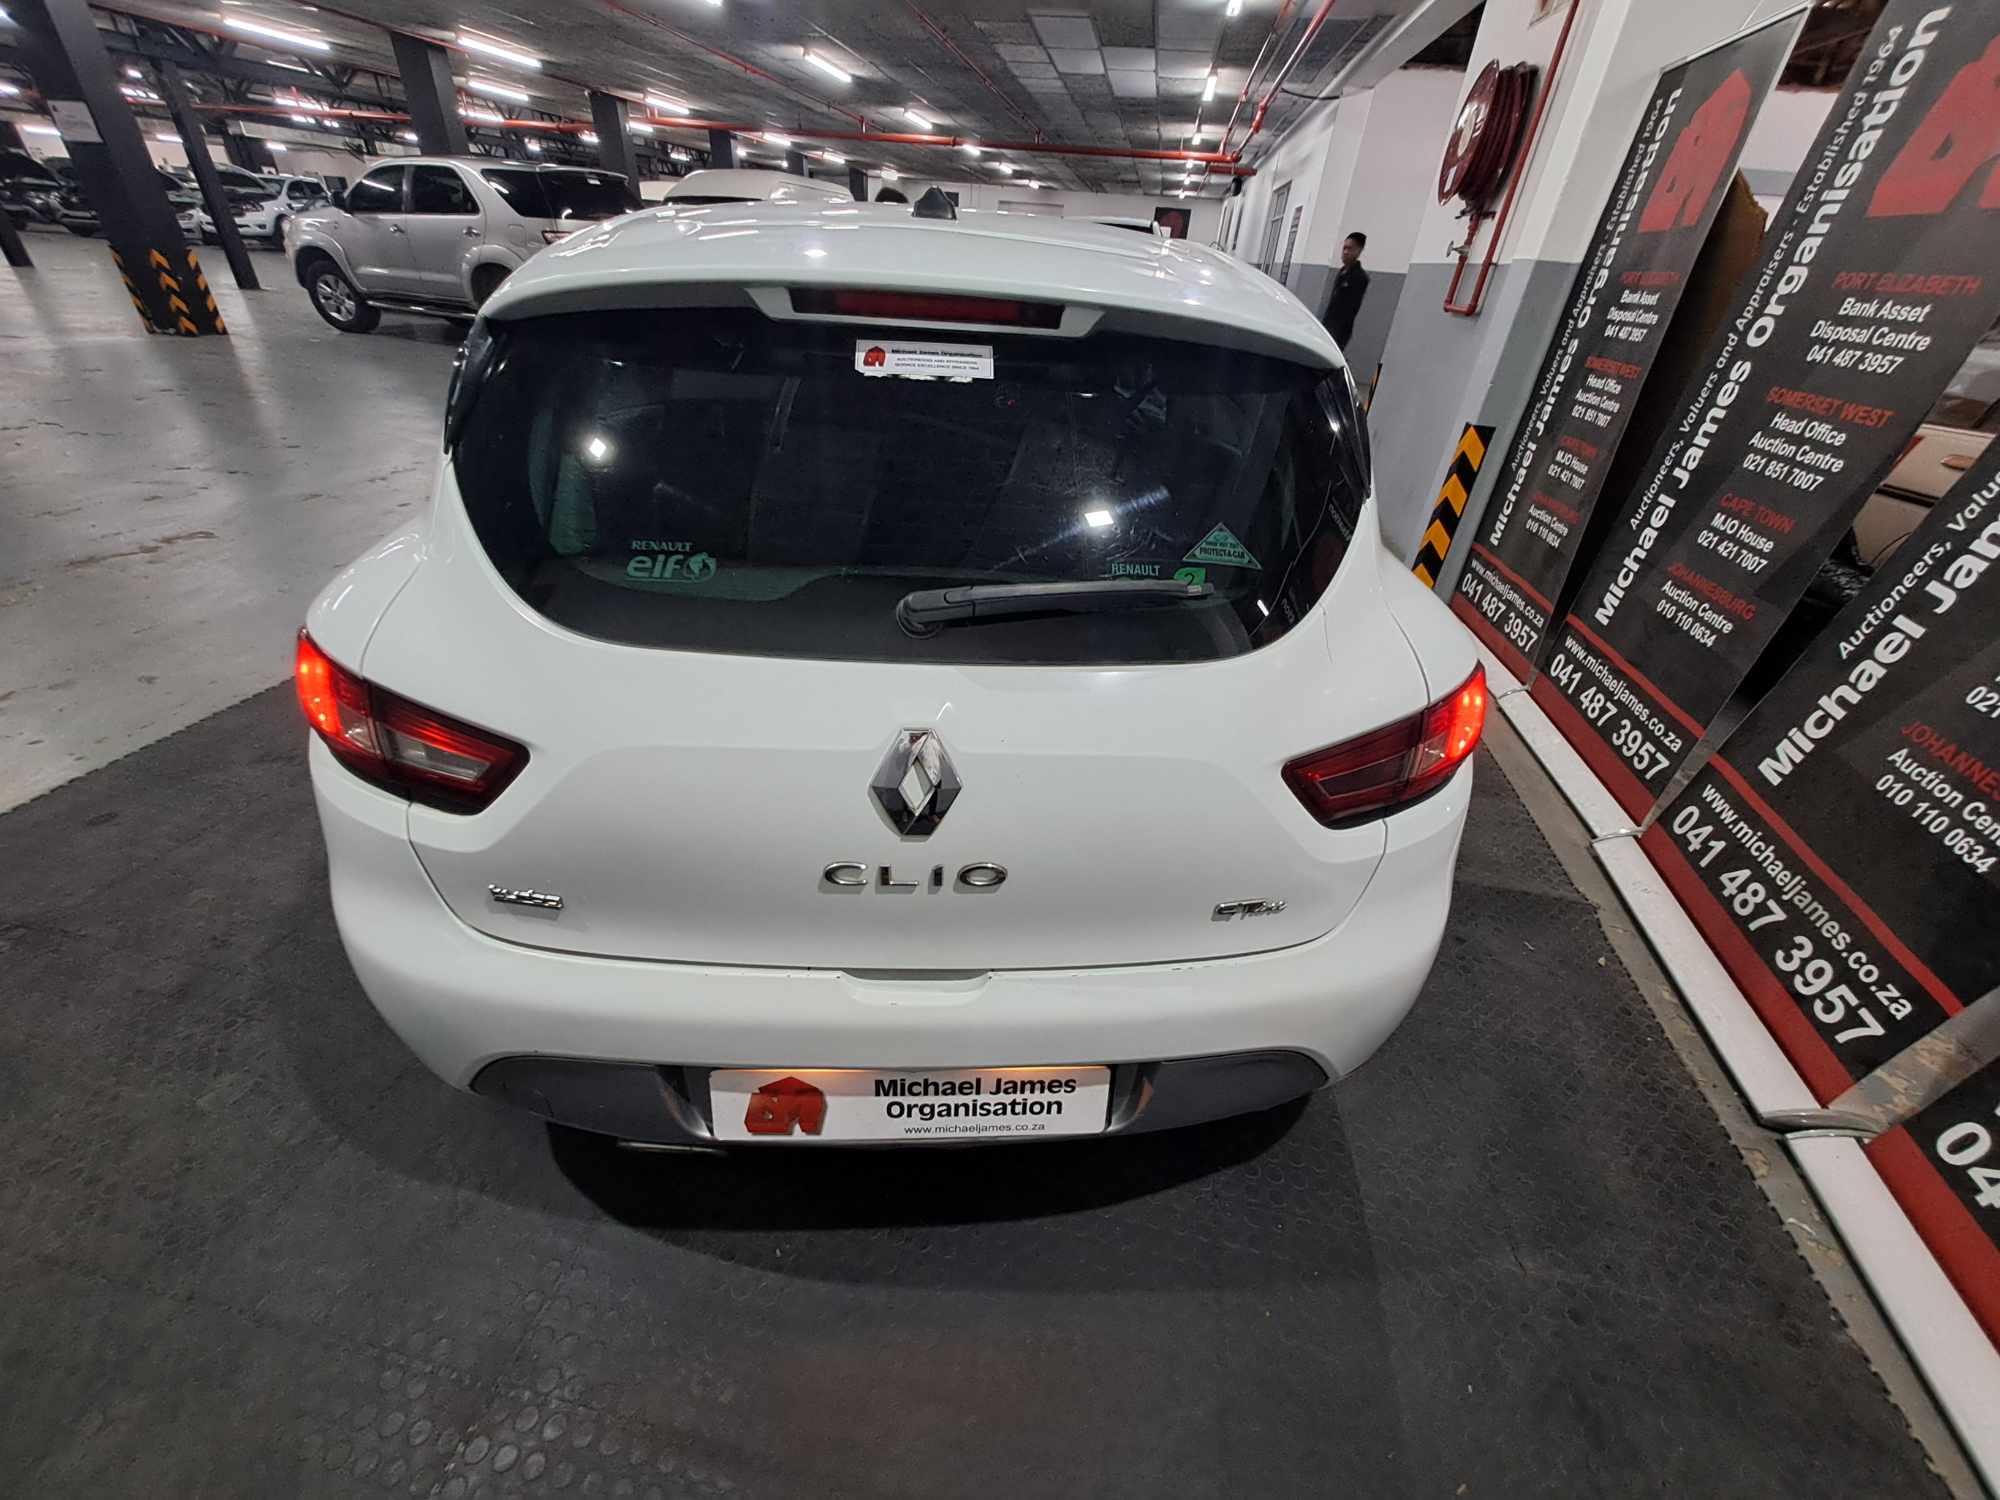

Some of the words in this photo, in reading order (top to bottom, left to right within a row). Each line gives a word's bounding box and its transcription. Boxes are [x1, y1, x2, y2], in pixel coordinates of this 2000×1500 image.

[1539, 350, 1563, 396] Valuers
[1562, 318, 1575, 346] and
[1573, 244, 1607, 317] Appraisers
[1606, 143, 1647, 231] Established
[1630, 439, 1685, 530] Auctioneers,
[1679, 371, 1718, 433] Valuers
[1716, 333, 1739, 368] and
[1736, 231, 1794, 332] Appraisers
[1796, 92, 1869, 213] Established
[1863, 25, 1903, 86] 1964
[1832, 272, 1876, 289] PORT
[1489, 442, 1537, 546] Michael
[1536, 338, 1579, 437] James
[1577, 87, 1683, 329] Organisation
[1593, 494, 1676, 627] Michael
[1672, 360, 1752, 489] James
[1746, 6, 1952, 347] Organisation
[1838, 297, 1879, 317] Bank
[1877, 300, 1933, 323] Asset
[1810, 320, 1875, 343] Disposal
[1872, 326, 1932, 351] Centre
[1806, 345, 1834, 364] 041
[1832, 349, 1863, 368] 487
[1858, 352, 1904, 374] 3957
[1766, 386, 1842, 416] SOMERSET
[1840, 403, 1895, 428] WEST
[1770, 411, 1808, 434] Head
[1804, 421, 1847, 446] Office
[1743, 453, 1767, 473] 021
[1765, 460, 1790, 480] 851
[1787, 468, 1824, 491] 7007
[1749, 431, 1796, 458] Auction
[1796, 446, 1844, 473] Centre
[1711, 512, 1739, 535] MJO
[1736, 526, 1774, 553] House
[1720, 492, 1755, 517] CAPE
[1754, 503, 1797, 534] TOWN
[626, 553, 684, 578] elf
[631, 540, 694, 552] RENAULT
[1697, 530, 1719, 553] 021
[1717, 540, 1740, 560] 421
[1736, 549, 1768, 574] 7007
[1111, 563, 1161, 577] RENAULT
[1462, 573, 1484, 603] 041
[1482, 592, 1507, 622] 487
[1504, 612, 1538, 652] 3957
[1661, 580, 1699, 611] Auction
[1698, 603, 1734, 634] Centre
[1838, 541, 1951, 660] Auctioneers,
[1656, 599, 1677, 619] 010
[1674, 610, 1693, 630] 110
[1690, 623, 1718, 648] 0634
[1565, 635, 1683, 753] www.michaeljames.co.za
[1757, 613, 1927, 787] Michael
[1550, 653, 1582, 695] 041
[1579, 686, 1618, 727] 487
[1612, 719, 1670, 780] 3957
[1887, 748, 1964, 808] Auction
[1875, 774, 1914, 806] 010
[1911, 802, 1950, 834] 110
[1944, 828, 1997, 874] 0634
[823, 861, 1008, 887] CLIO
[1701, 784, 1913, 1021] www.michaeljames.co.za
[1672, 805, 1727, 868] 041
[1719, 868, 1788, 932] 487
[1775, 935, 1886, 1045] 3957
[874, 1077, 981, 1097] Michael
[989, 1077, 1077, 1096] James
[886, 1098, 1063, 1121] Organisation
[904, 1123, 1045, 1134] www.michaeljames.co.za
